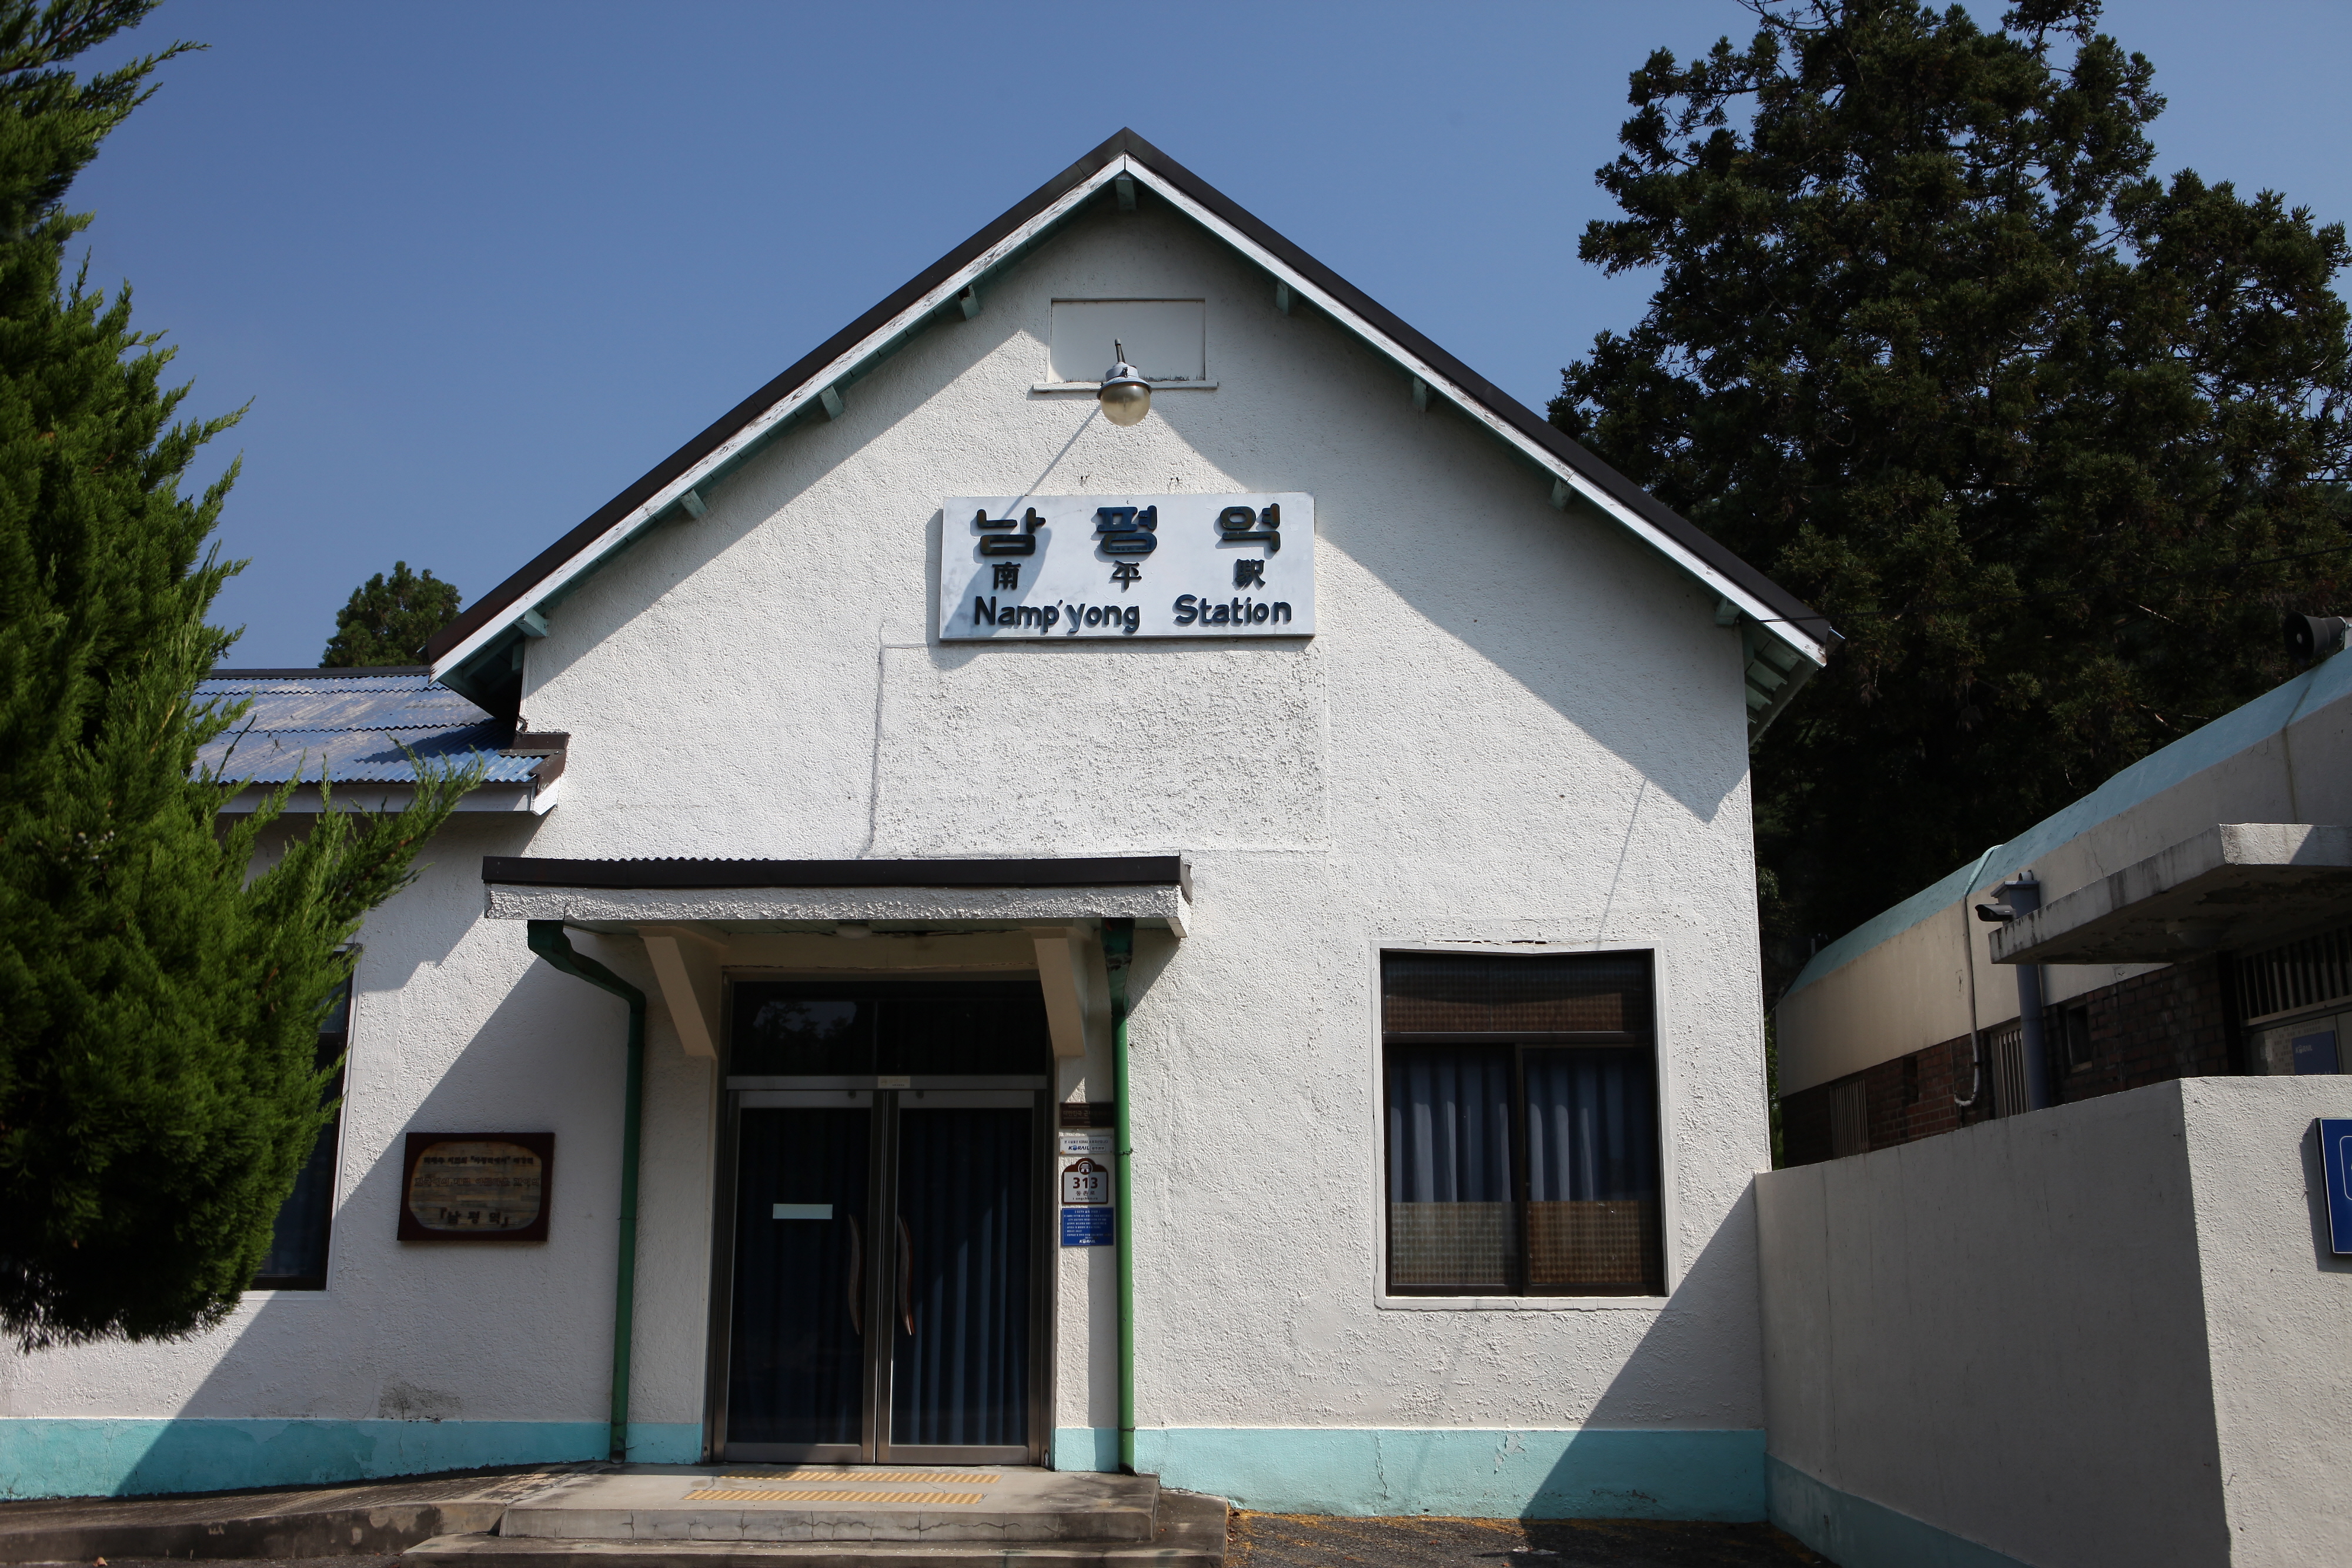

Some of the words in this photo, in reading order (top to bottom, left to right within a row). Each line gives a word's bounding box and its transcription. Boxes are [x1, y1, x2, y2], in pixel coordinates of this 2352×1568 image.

[977, 503, 1281, 555] 남평역
[1176, 594, 1292, 623] Station
[2296, 1045, 2313, 1054] KORAIL
[1073, 1177, 1098, 1189] 313
